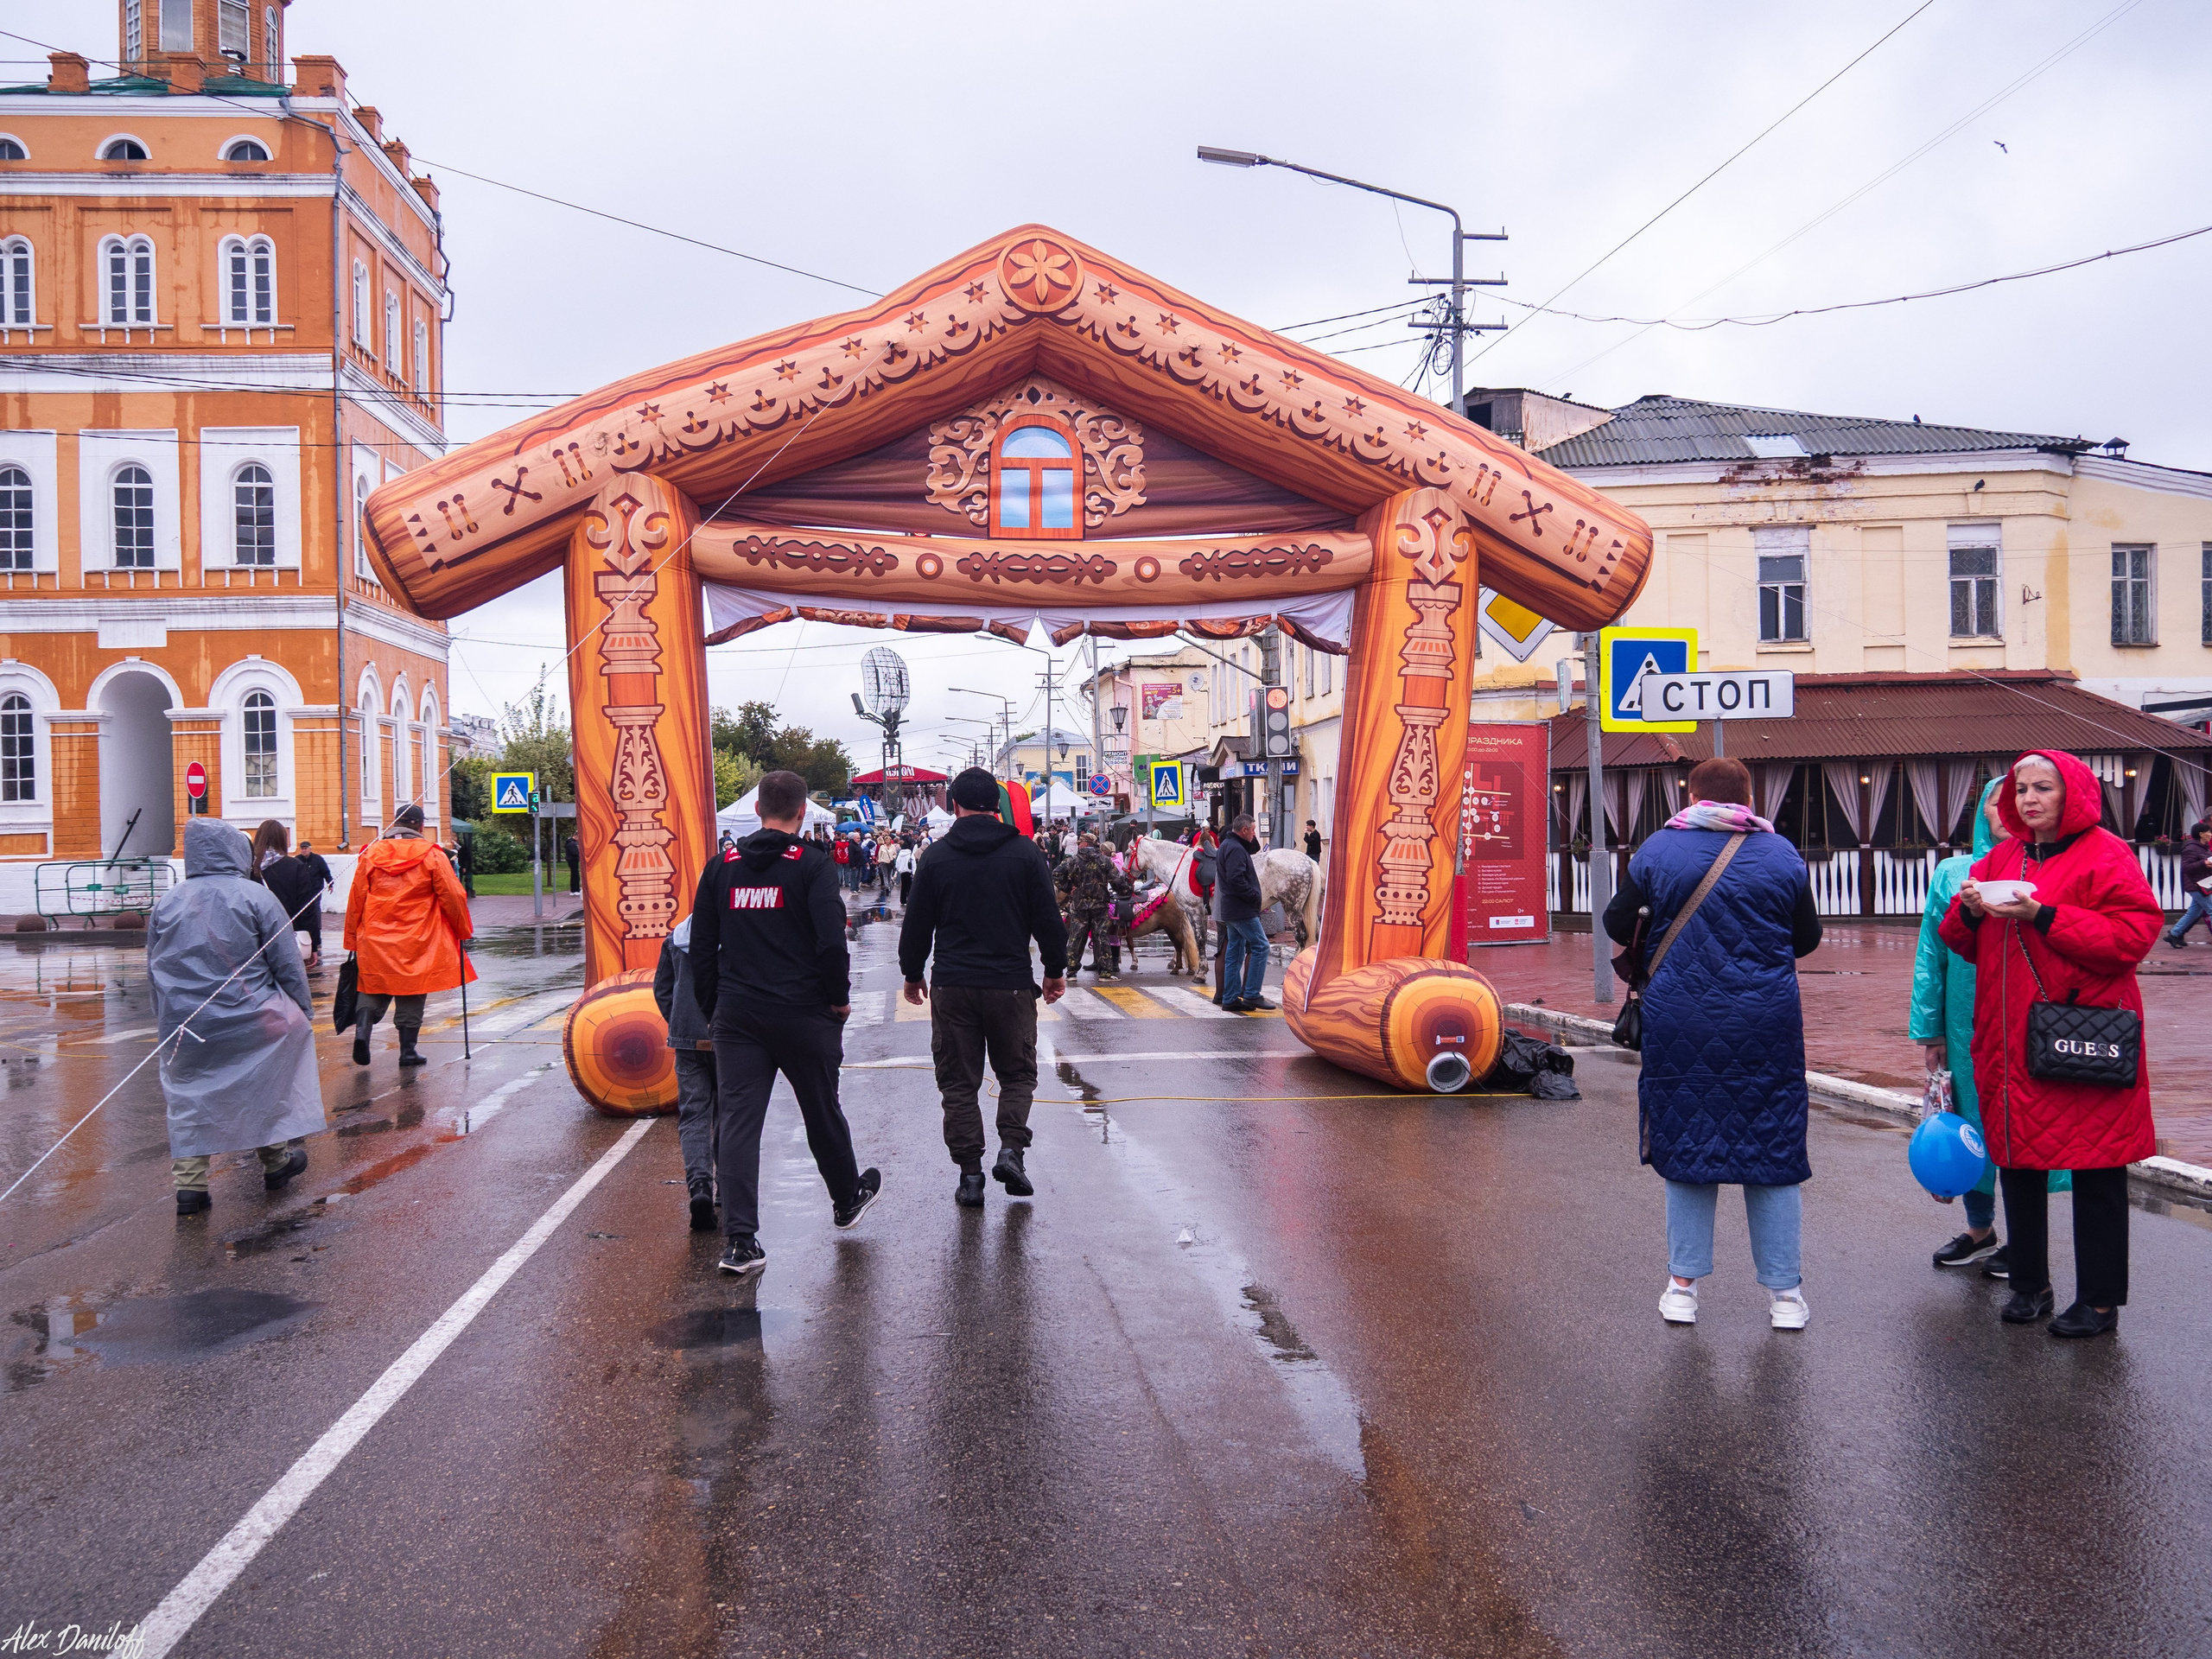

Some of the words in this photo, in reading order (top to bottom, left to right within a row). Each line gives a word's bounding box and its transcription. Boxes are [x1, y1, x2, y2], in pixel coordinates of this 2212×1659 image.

[1662, 679, 1770, 711] СТОП
[1246, 762, 1296, 772] ТКИ
[734, 887, 779, 908] WWW
[2054, 1039, 2120, 1058] GUESS
